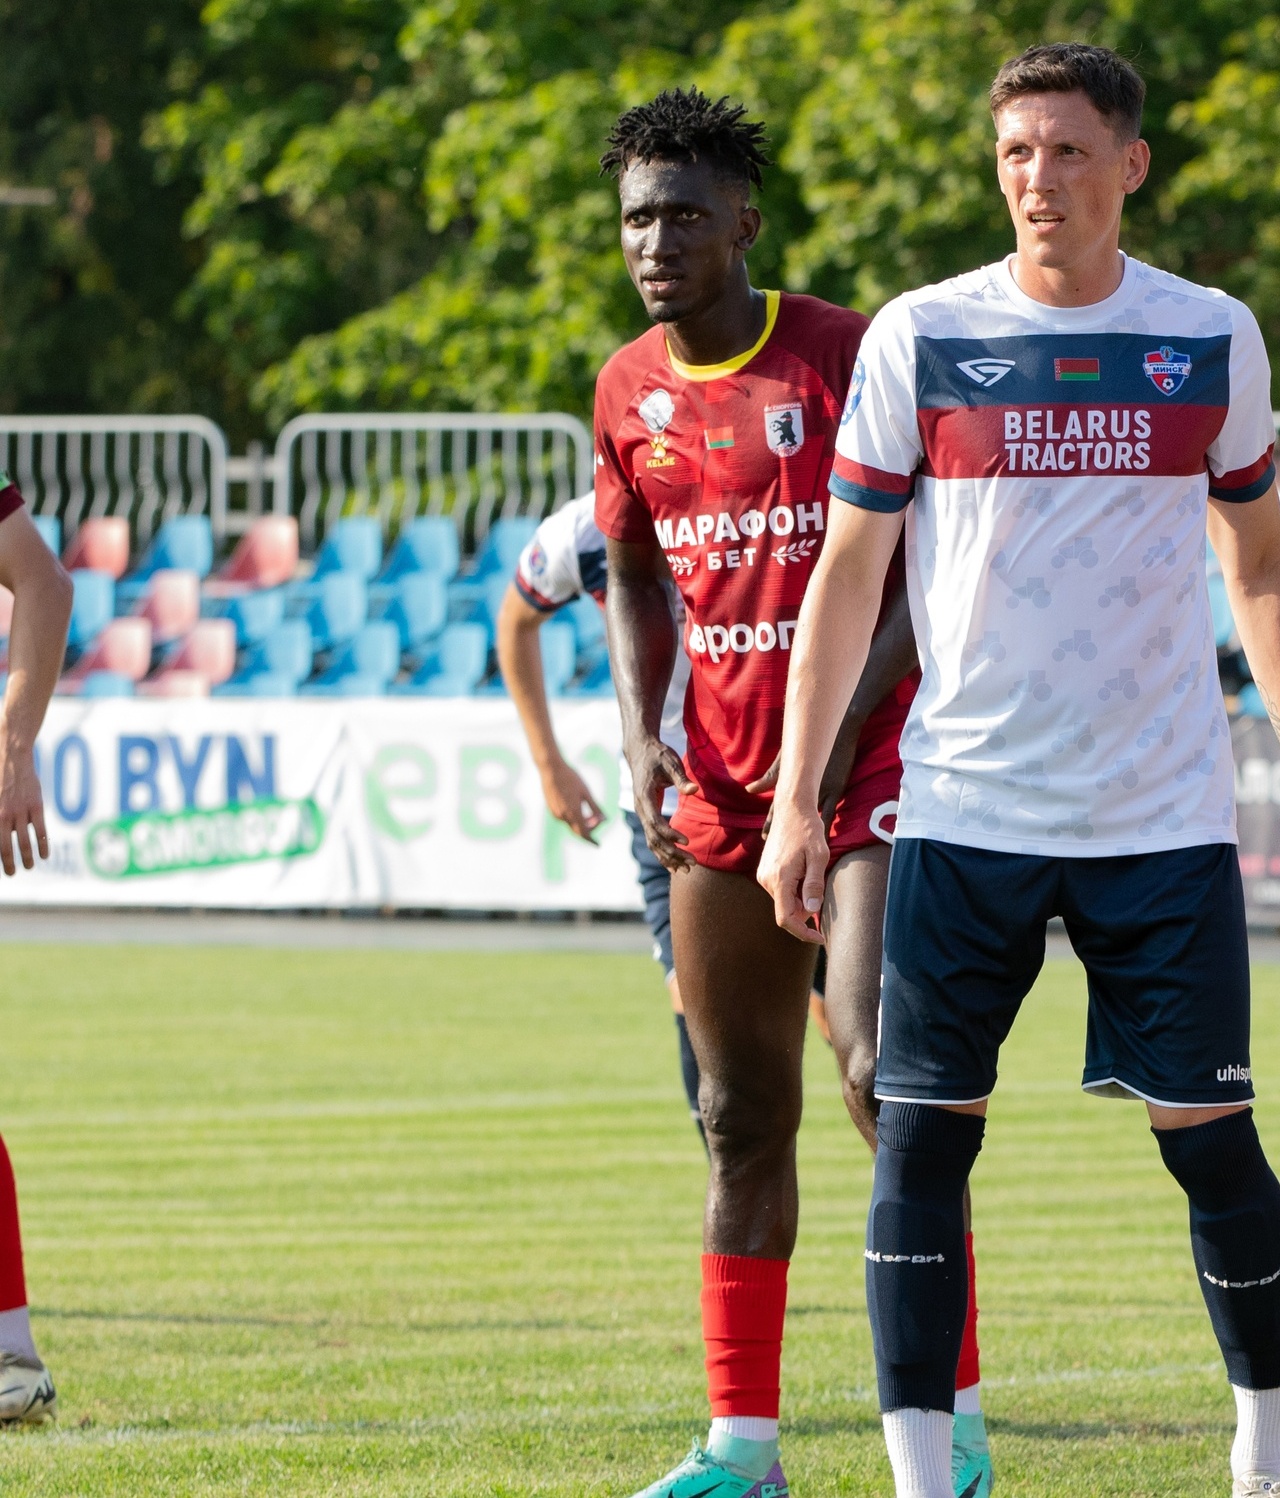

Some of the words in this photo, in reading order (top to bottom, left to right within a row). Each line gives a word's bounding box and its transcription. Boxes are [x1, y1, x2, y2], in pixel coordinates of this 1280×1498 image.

[1153, 366, 1184, 374] МИНСК
[1004, 409, 1152, 441] BELARUS
[646, 456, 676, 469] KELME
[1004, 442, 1152, 471] TRACTORS
[654, 501, 825, 550] МАРАФОН
[707, 547, 757, 571] БЕТ
[117, 733, 278, 816] BYN
